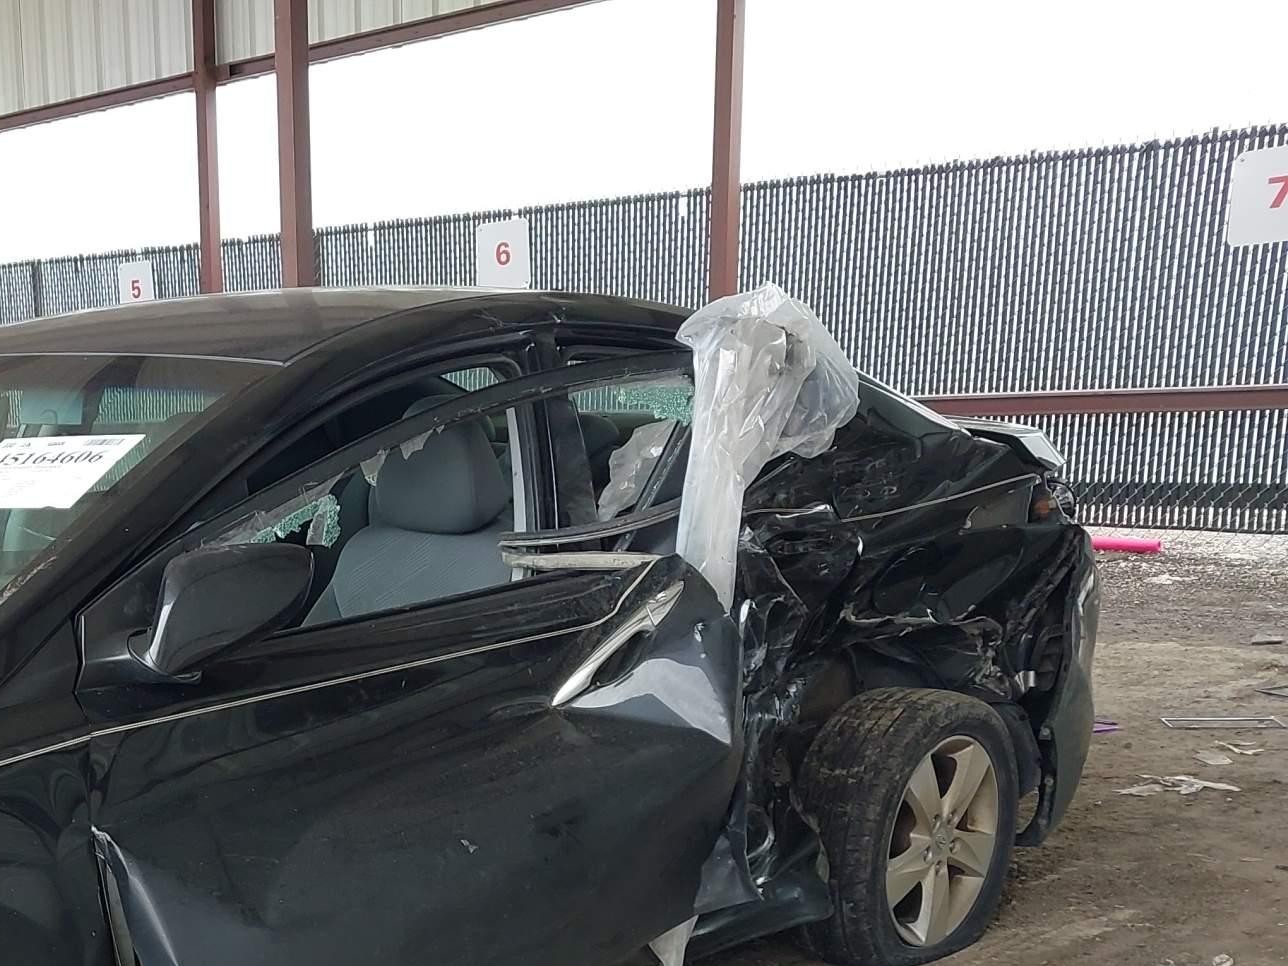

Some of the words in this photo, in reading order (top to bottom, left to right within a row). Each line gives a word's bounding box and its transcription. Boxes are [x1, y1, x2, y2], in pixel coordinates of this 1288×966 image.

[1268, 175, 1288, 208] 7
[495, 241, 511, 266] 6
[131, 279, 142, 299] 5
